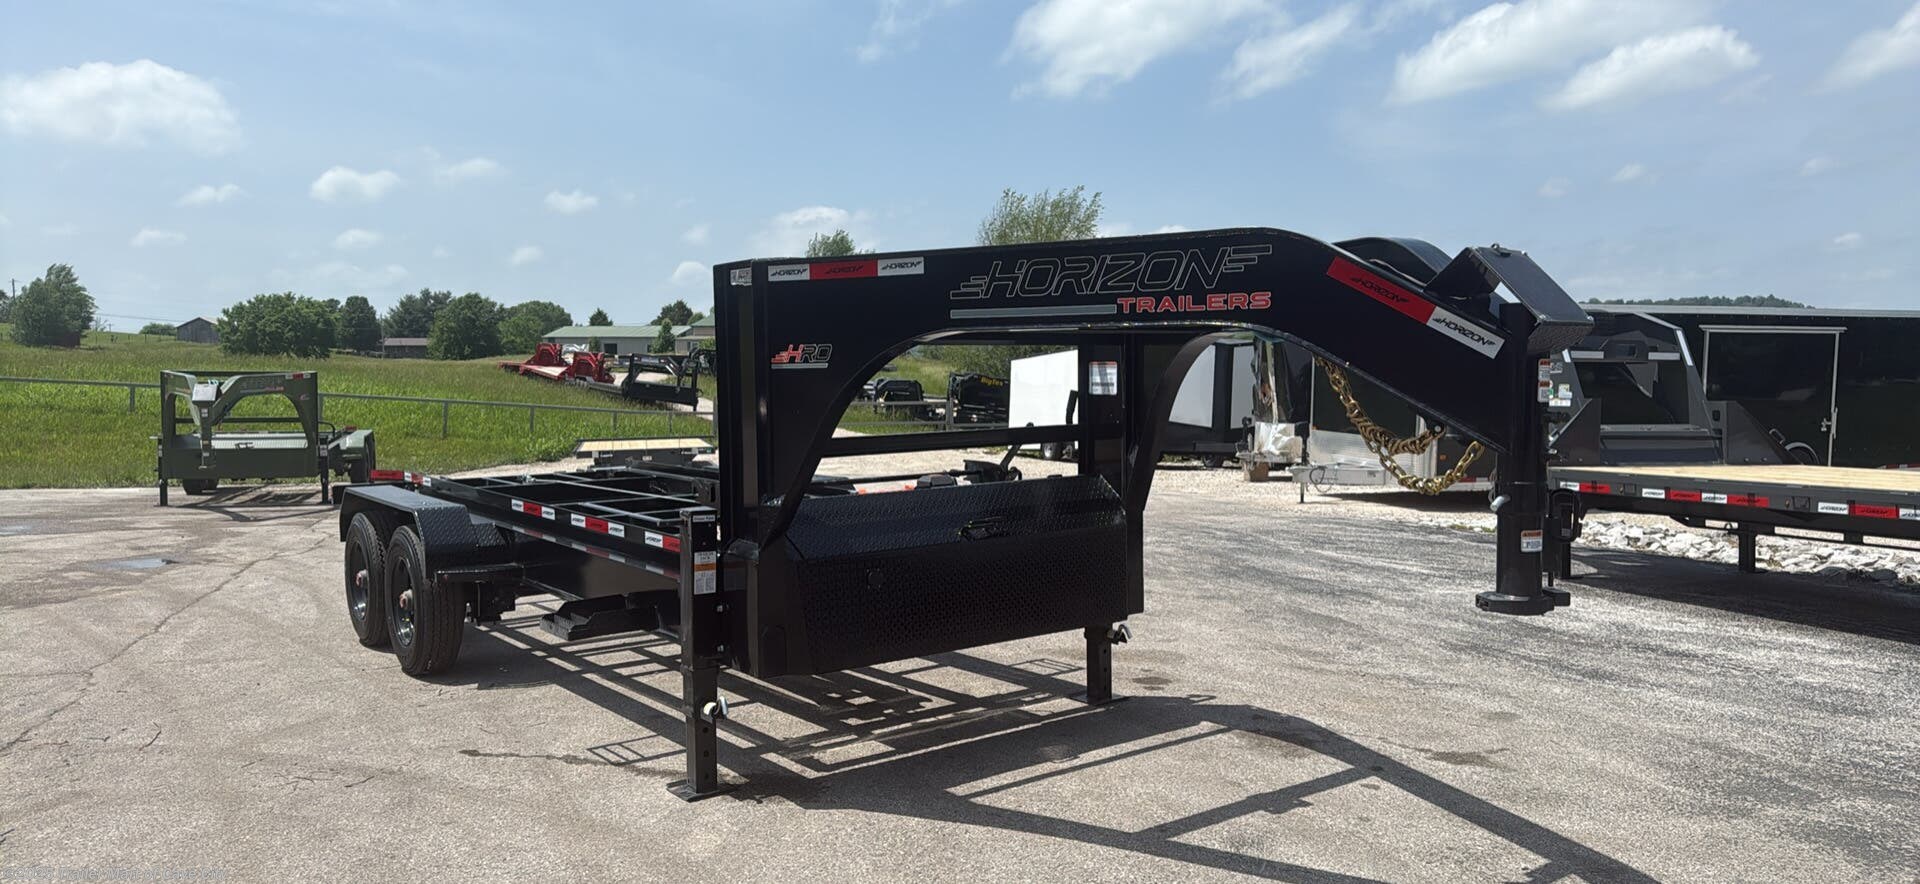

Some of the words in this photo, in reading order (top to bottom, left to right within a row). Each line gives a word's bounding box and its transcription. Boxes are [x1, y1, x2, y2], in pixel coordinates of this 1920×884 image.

[771, 268, 807, 277] HORIZON
[881, 261, 921, 271] HORIZON
[980, 246, 1231, 298] HORIZON
[1354, 277, 1406, 304] HORIZON
[1117, 292, 1272, 314] TRAILERS
[1435, 317, 1494, 346] HORIZON
